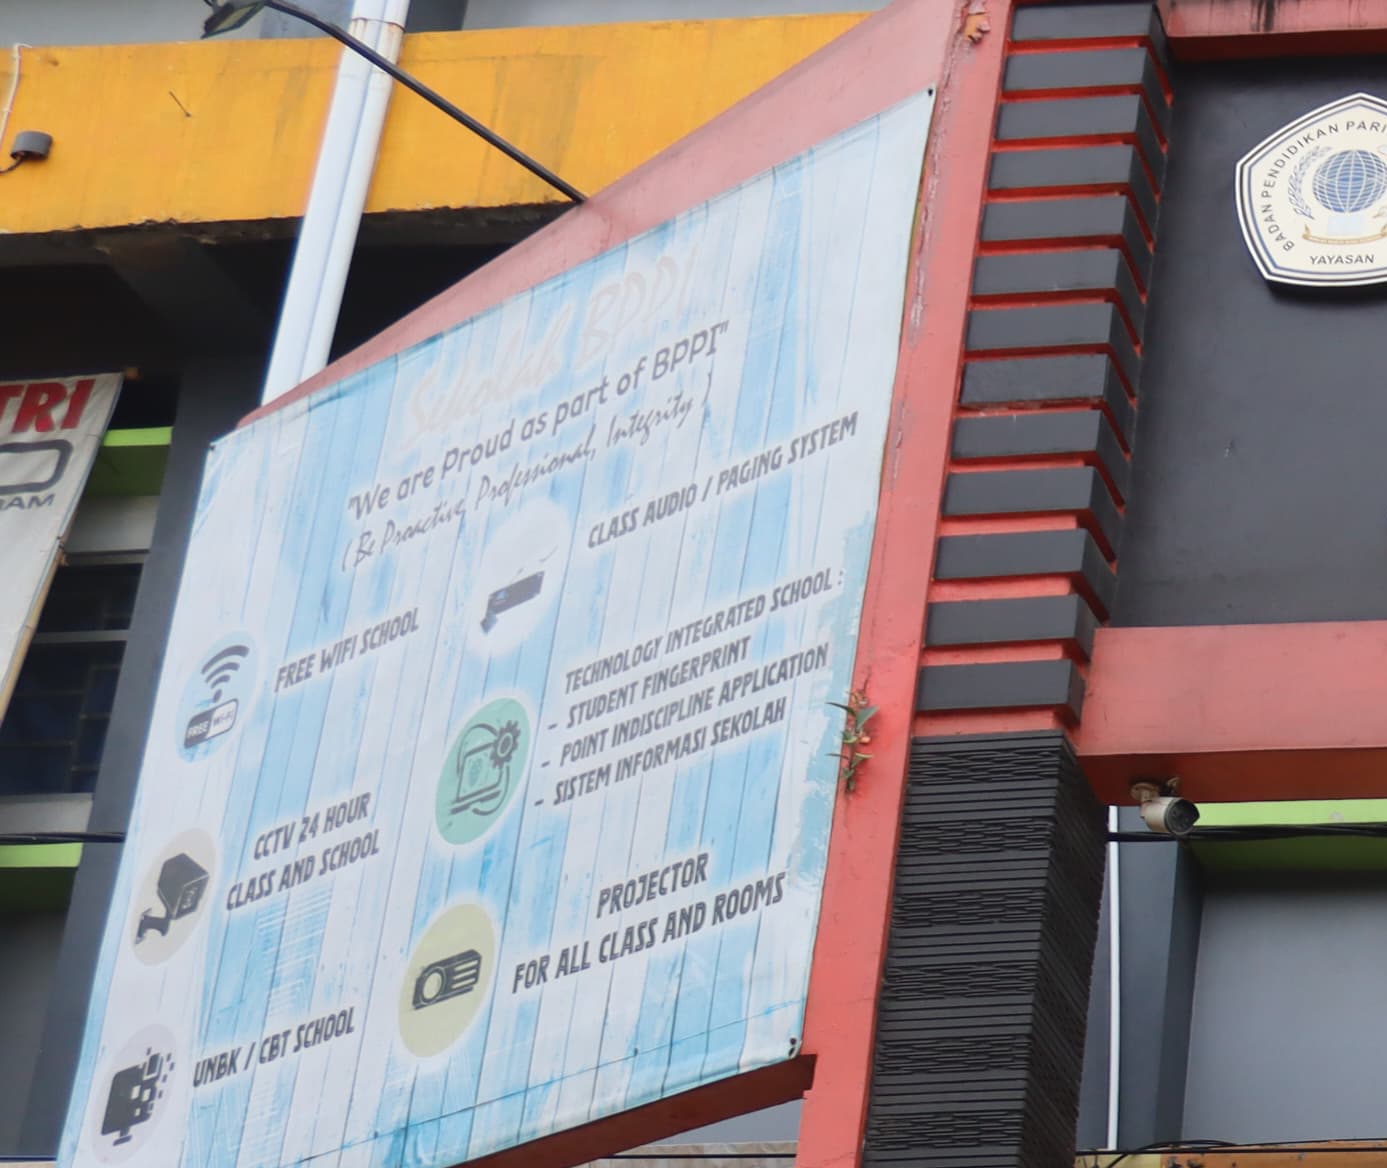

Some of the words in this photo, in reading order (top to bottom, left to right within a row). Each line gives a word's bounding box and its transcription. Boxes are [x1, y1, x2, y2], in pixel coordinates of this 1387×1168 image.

[1262, 124, 1338, 198] PENDIDIKAN
[1261, 203, 1296, 252] BADAN
[1310, 254, 1375, 265] YAYASAN
[402, 302, 573, 450] Sekolah
[575, 252, 697, 370] BPPI
[398, 468, 433, 500] are
[442, 419, 515, 479] Proud
[520, 412, 547, 441] as
[553, 378, 609, 436] part
[617, 355, 647, 396] of
[607, 395, 692, 448] Integrity
[588, 508, 639, 549] CLASS
[643, 485, 697, 525] AUDIO
[702, 477, 713, 502] /
[717, 450, 781, 497] PAGING
[788, 412, 858, 464] SYSTEM
[274, 654, 315, 692] FREE
[320, 642, 356, 672] WIFI
[360, 607, 419, 653] SCHOOL
[565, 635, 661, 694] TECHNOLOGY
[665, 595, 765, 655] INTEGRATED
[770, 568, 832, 612] SCHOOL
[560, 730, 608, 766] POINT
[612, 687, 714, 747] INDISCIPLINE
[718, 642, 828, 704] APPLICATION
[567, 681, 637, 728] STUDENT
[642, 635, 752, 699] FINGERPRINT
[554, 767, 610, 805] SISTEM
[615, 730, 706, 779] INFORMASI
[710, 696, 786, 746] SEKOLAH
[254, 822, 296, 860] CCTV
[299, 809, 319, 842] 24
[324, 793, 371, 834] HOUR
[227, 875, 276, 910] CLASS
[278, 853, 314, 891] AND
[319, 830, 379, 872] SCHOOL
[597, 852, 708, 919] PROJECTOR
[513, 954, 548, 994] FOR
[555, 941, 589, 980] ALL
[600, 918, 656, 964] CLASS
[662, 902, 705, 943] AND
[712, 872, 786, 926] ROOMS
[194, 1047, 238, 1087] UNBK
[244, 1041, 254, 1071] /
[259, 1031, 290, 1064] CBT
[293, 1006, 355, 1052] SCHOOL
